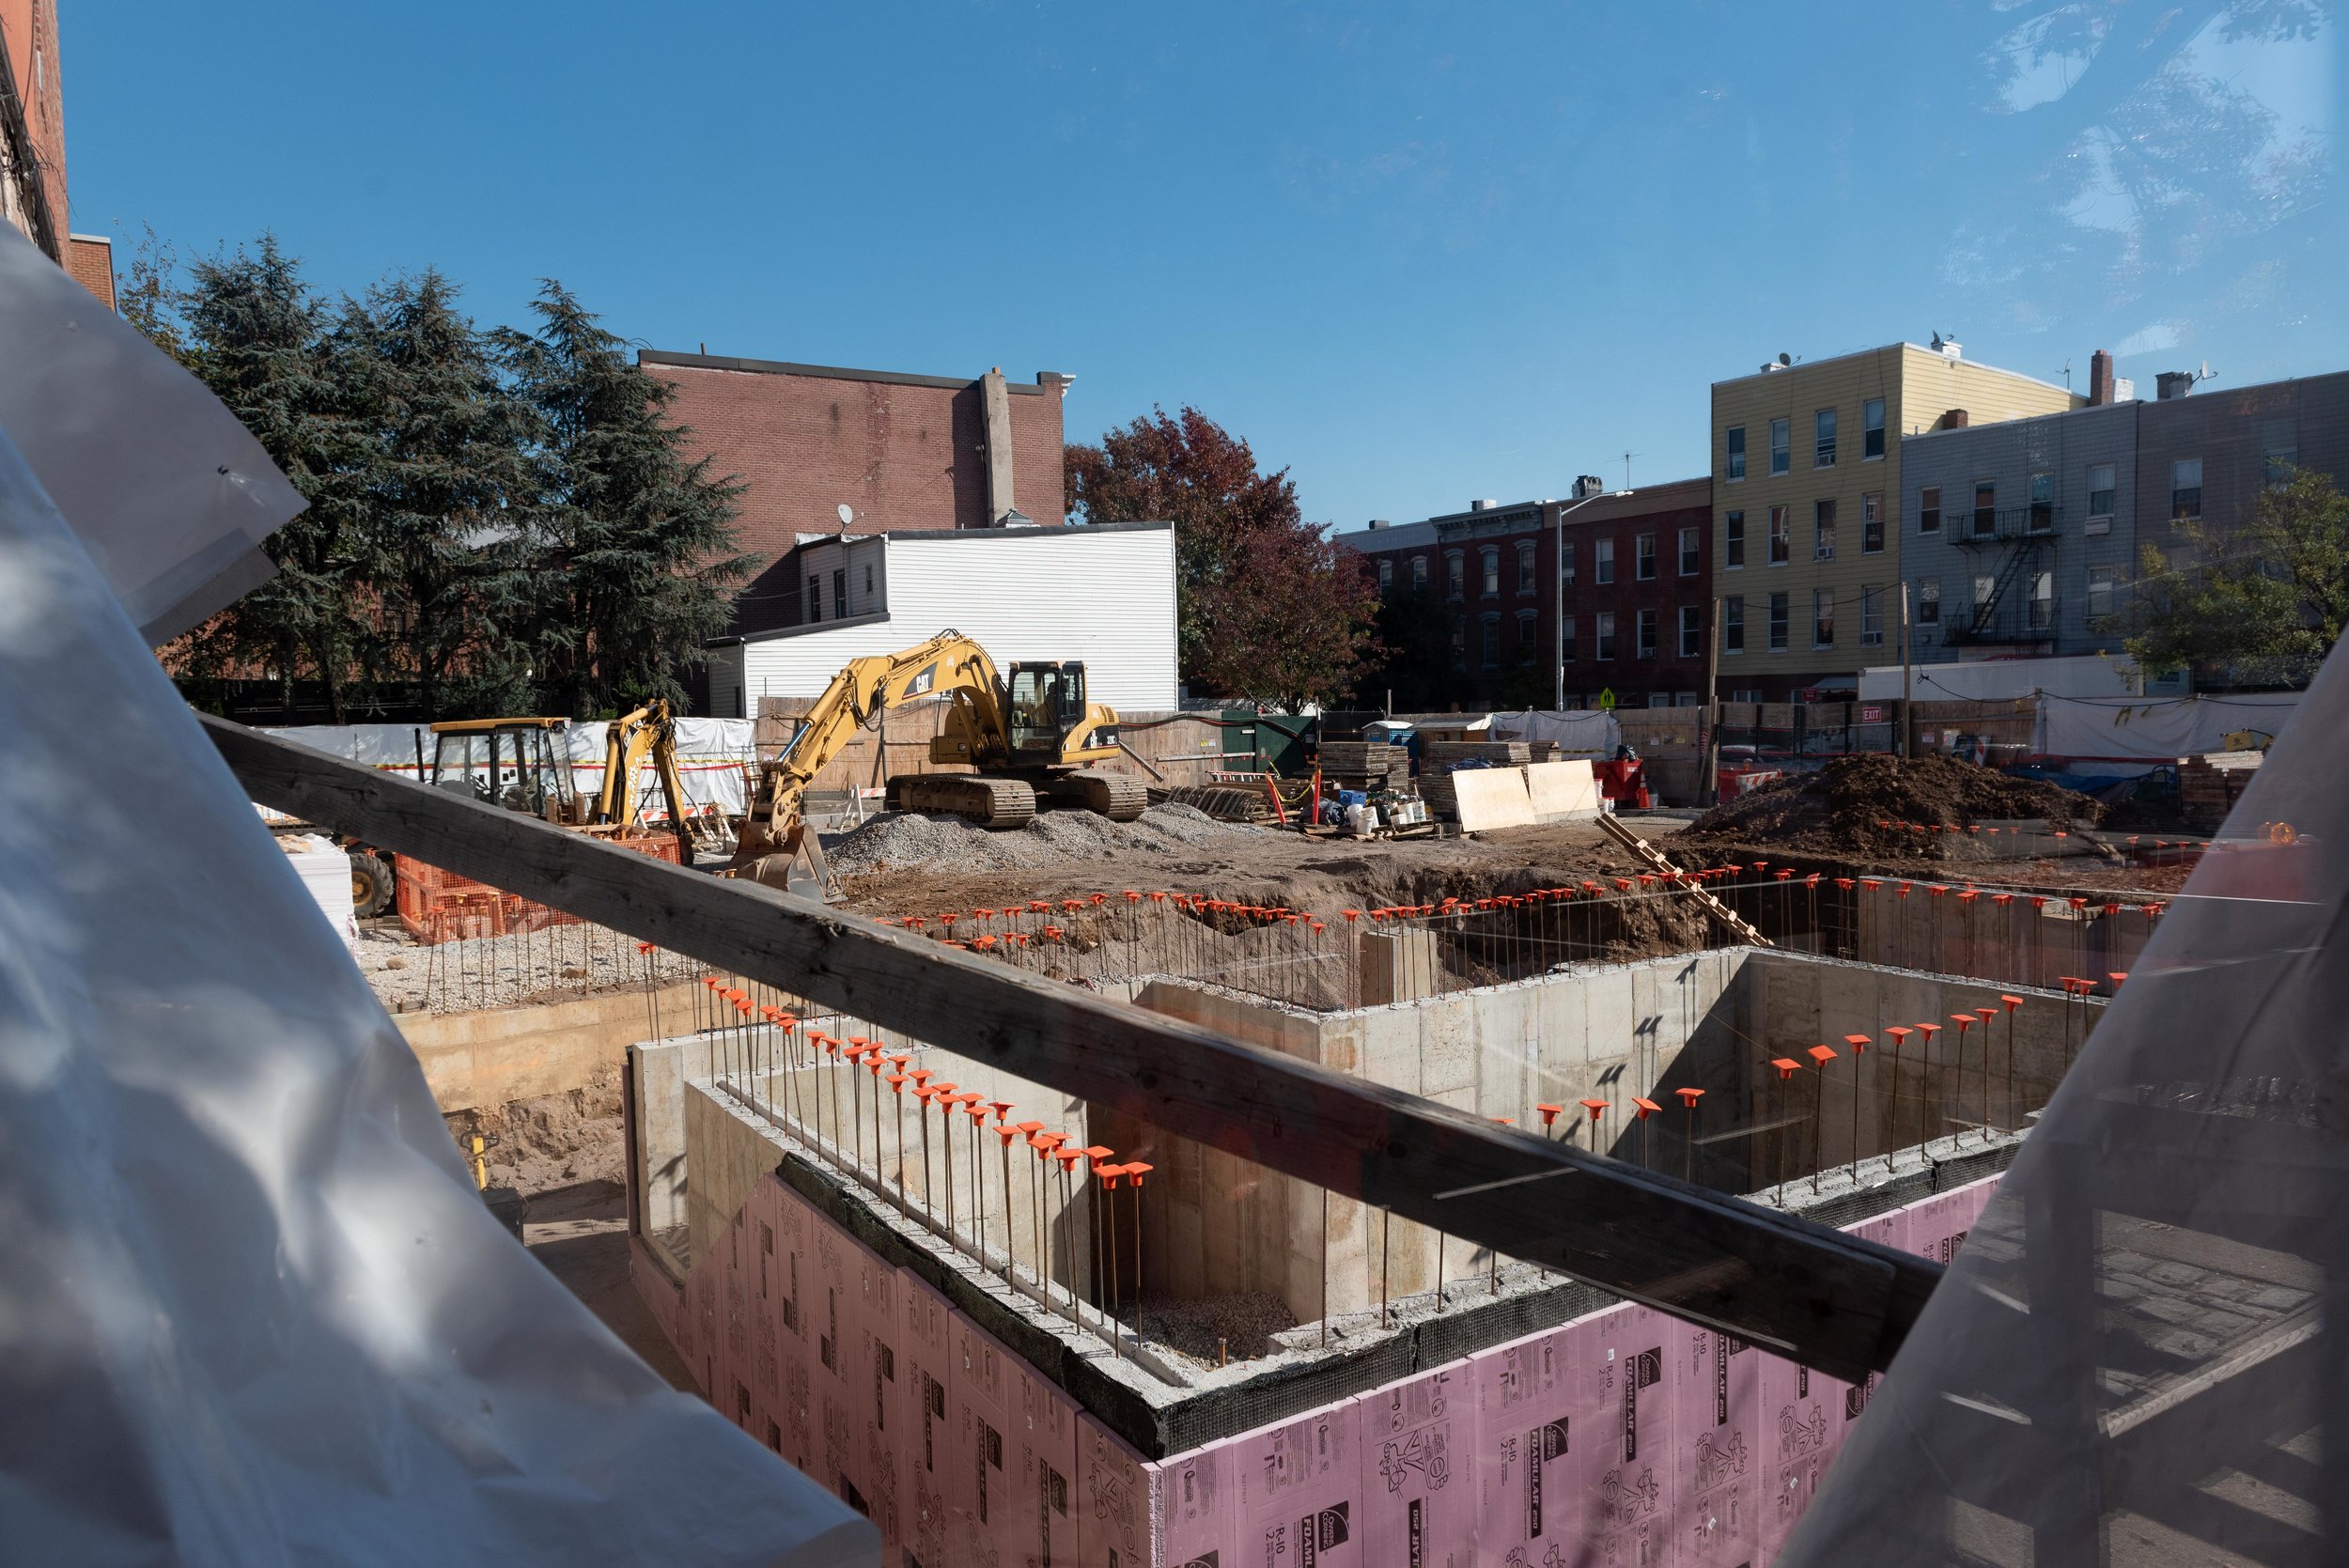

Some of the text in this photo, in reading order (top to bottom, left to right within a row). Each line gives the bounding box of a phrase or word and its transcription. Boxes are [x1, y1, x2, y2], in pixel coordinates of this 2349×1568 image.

[916, 674, 929, 694] CAT
[1864, 709, 1880, 721] EXIT
[1508, 1437, 1517, 1462] R-10
[1266, 1531, 1274, 1541] 2
[1275, 1527, 1285, 1554] R-10
